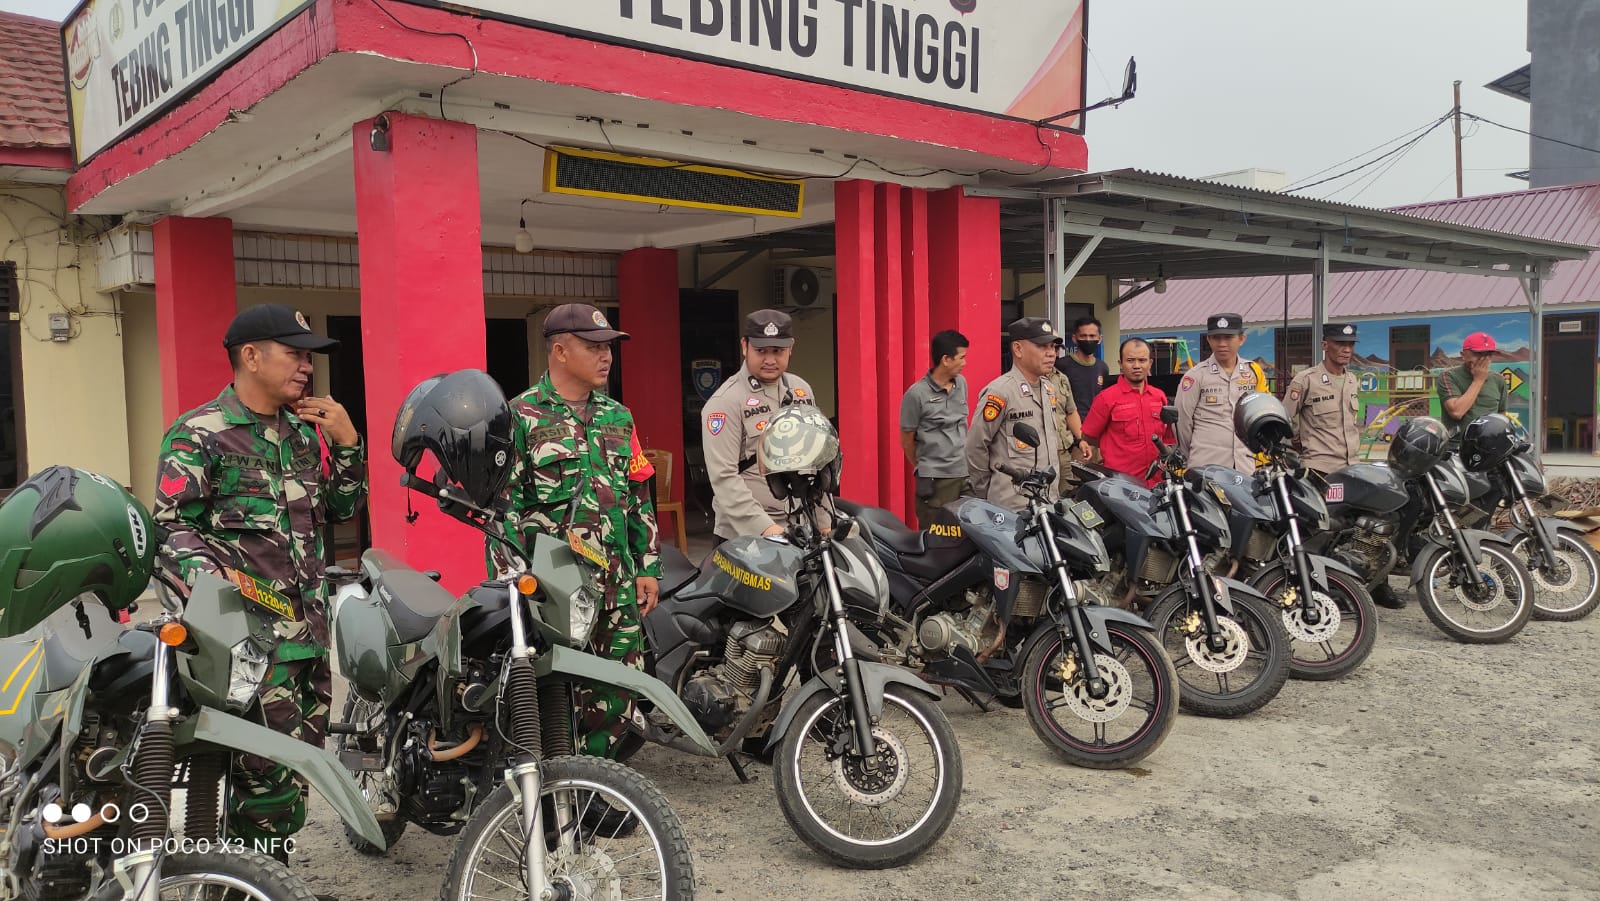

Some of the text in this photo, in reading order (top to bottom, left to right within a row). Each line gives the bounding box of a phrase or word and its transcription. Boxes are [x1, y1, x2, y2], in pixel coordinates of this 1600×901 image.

[111, 22, 173, 128] TEBING
[620, 0, 979, 93] BING TINGGI
[744, 405, 771, 418] DANDI
